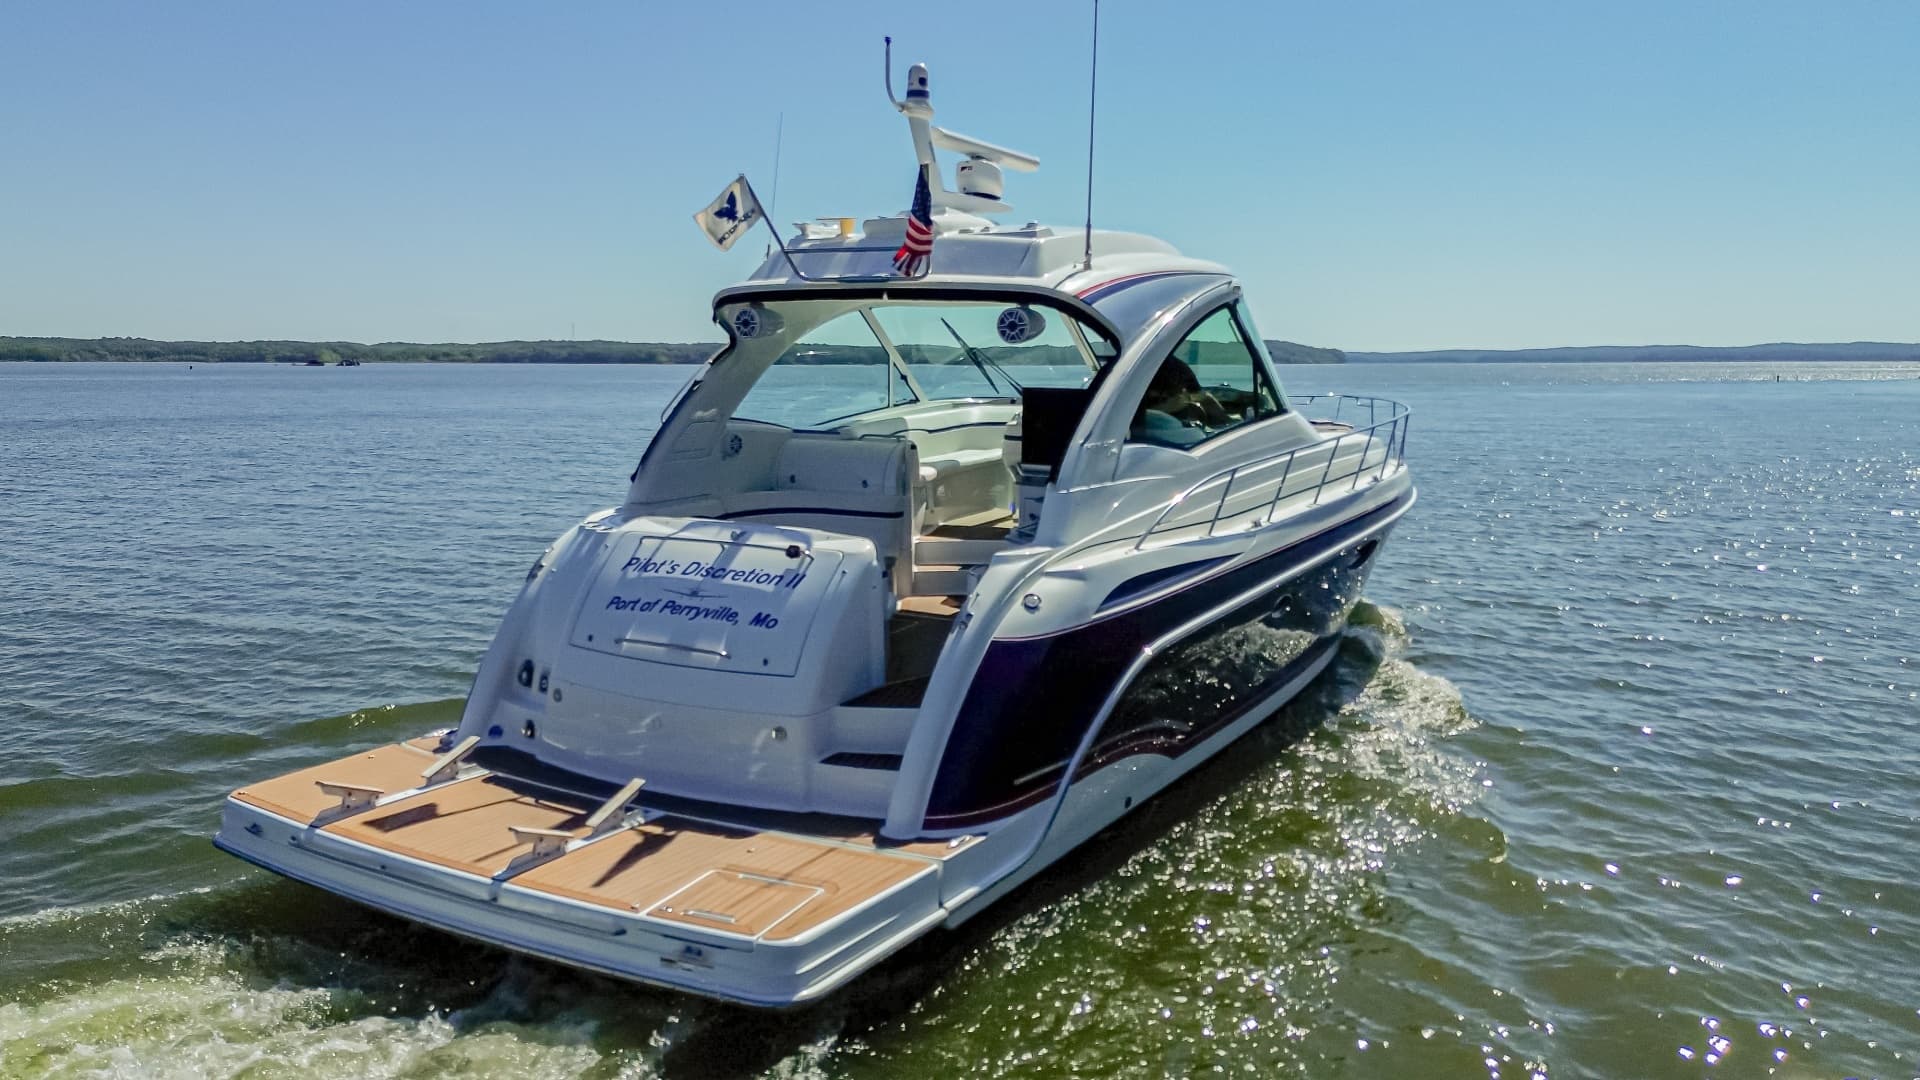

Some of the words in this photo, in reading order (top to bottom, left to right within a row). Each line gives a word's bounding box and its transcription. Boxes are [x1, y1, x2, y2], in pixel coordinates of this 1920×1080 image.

[621, 557, 680, 575] Pilot's
[681, 561, 784, 587] Discretion
[606, 596, 642, 611] Port
[639, 598, 662, 612] of
[659, 600, 740, 626] Perryville,
[748, 612, 779, 629] Mo
